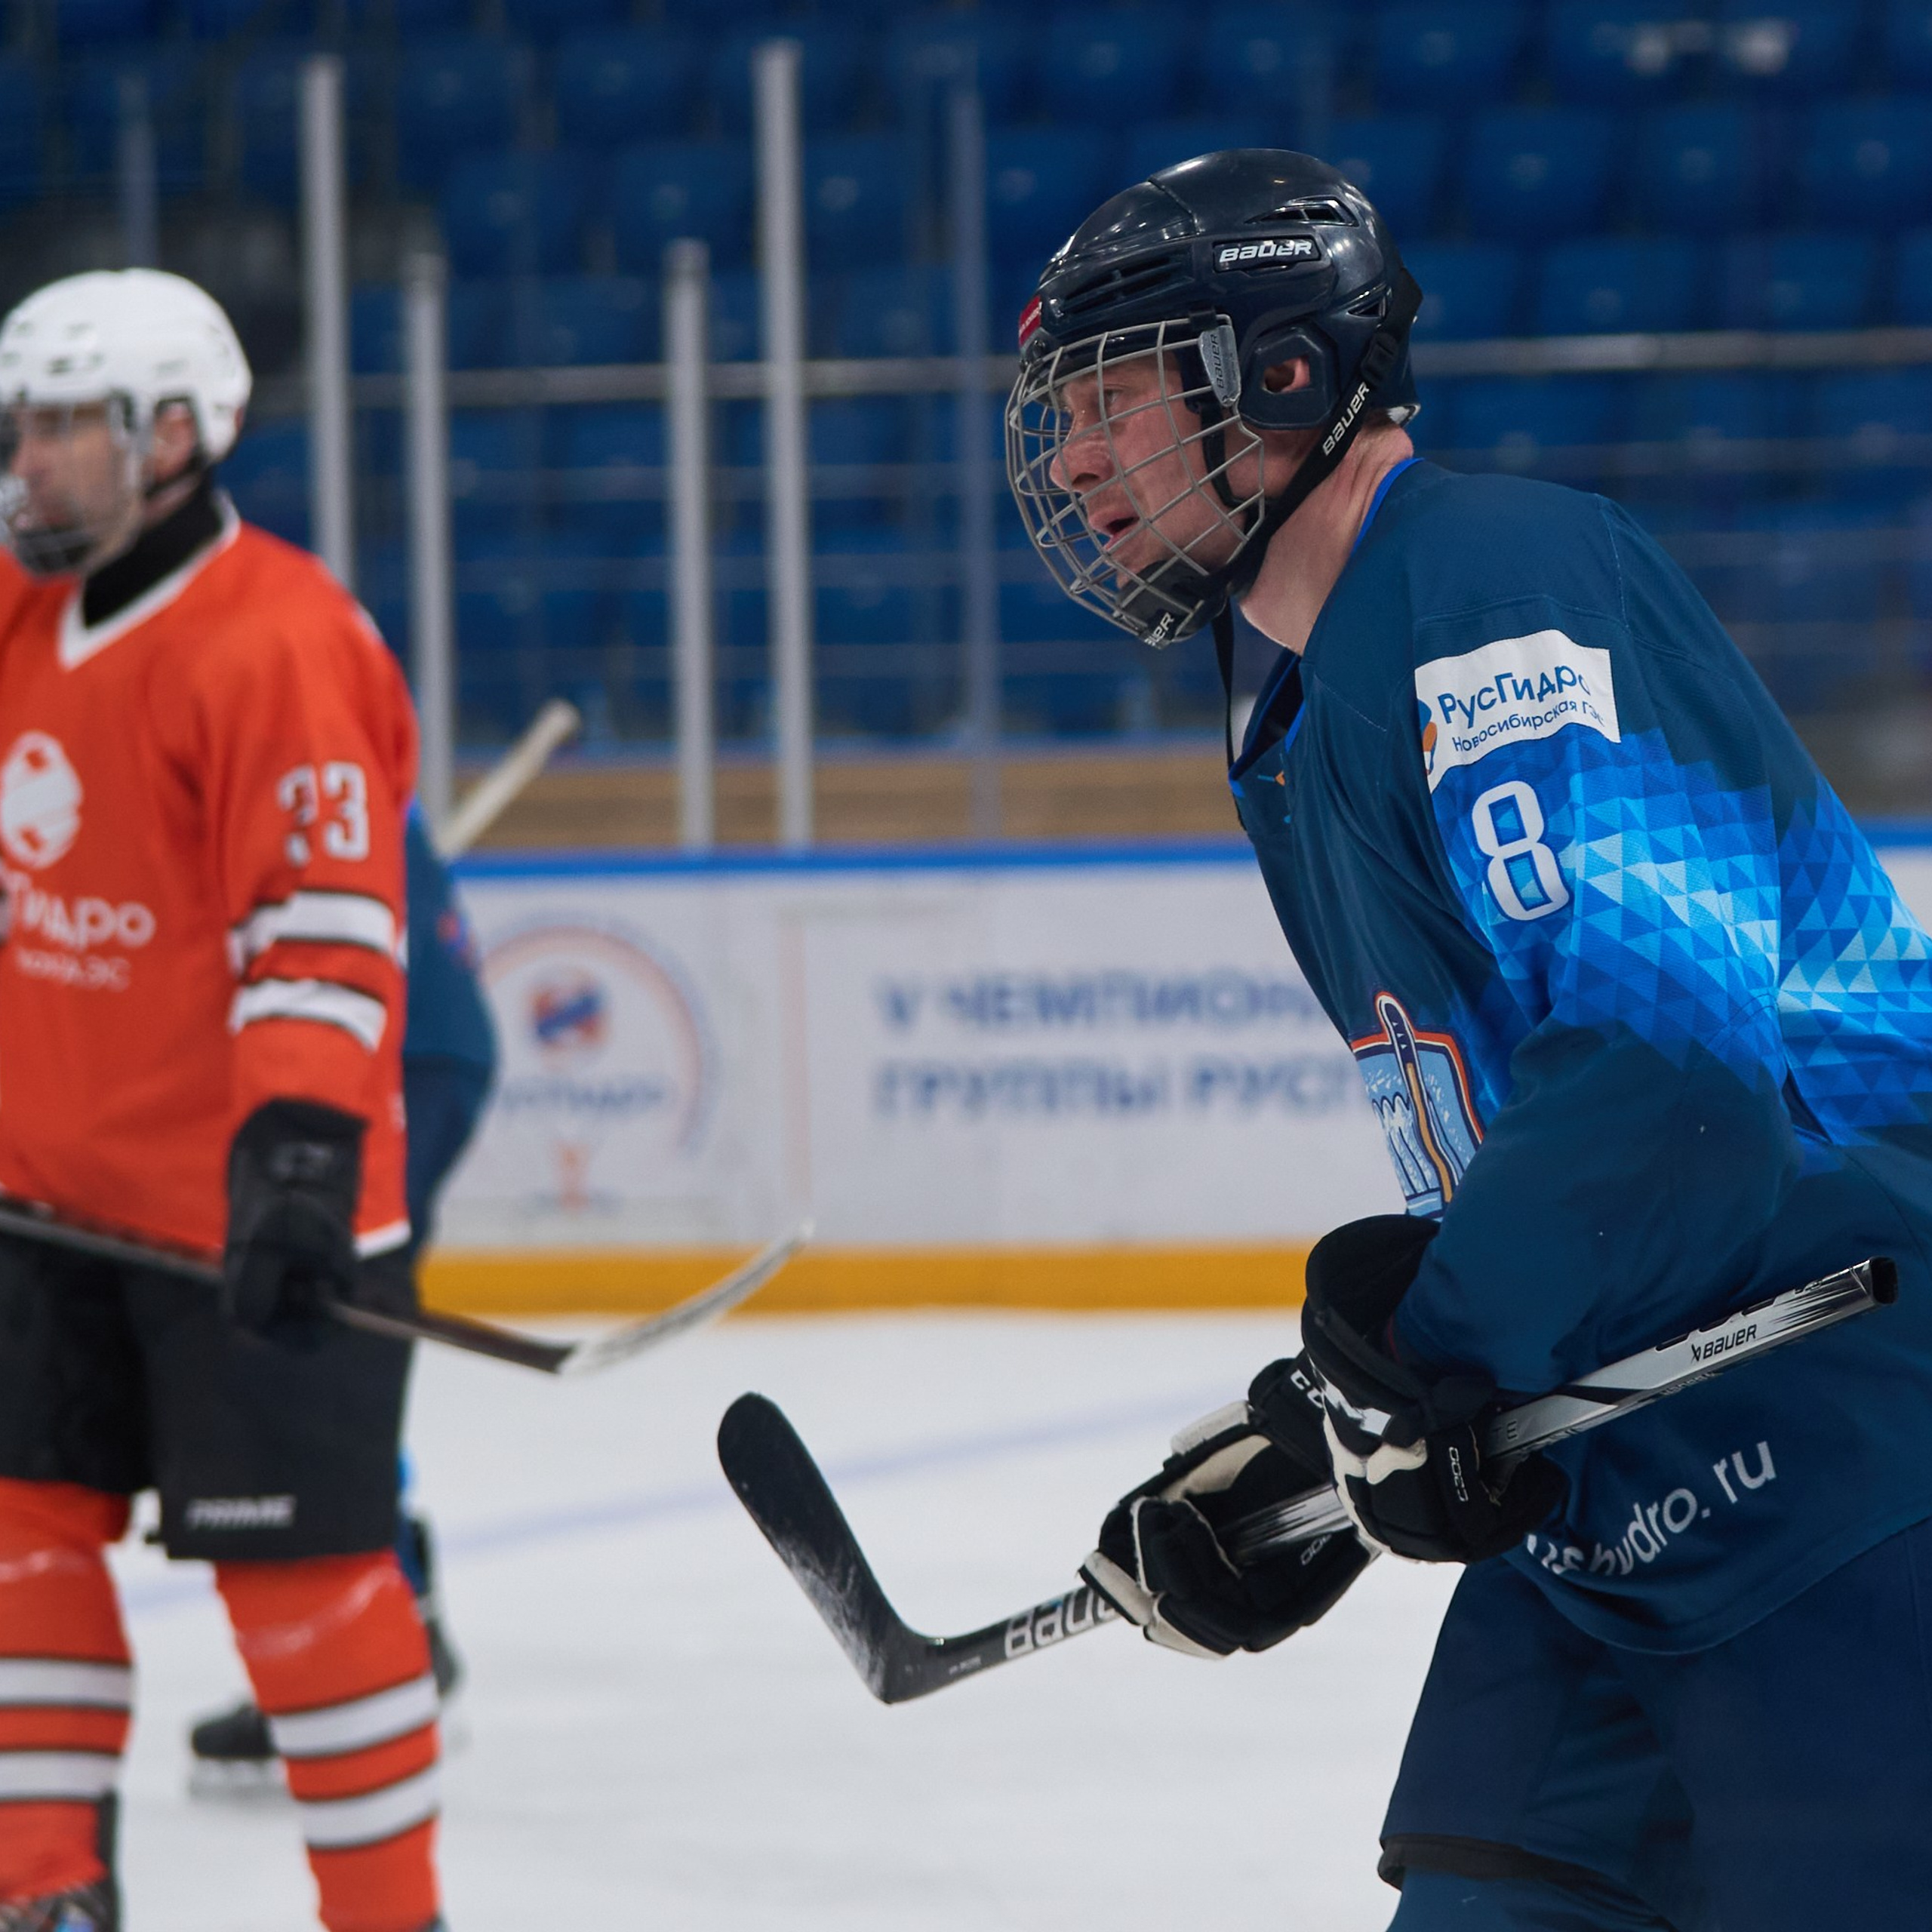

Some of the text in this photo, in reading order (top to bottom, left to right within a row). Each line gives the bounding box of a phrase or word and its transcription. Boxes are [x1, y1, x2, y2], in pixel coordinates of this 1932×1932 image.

[1219, 241, 1312, 263] BAUER
[1210, 334, 1224, 389] BAUER
[1322, 382, 1370, 456] BAUER
[1452, 700, 1577, 752] Новосибирская
[1472, 780, 1570, 921] 8
[942, 972, 1325, 1032] ЧЕМПИОН
[1703, 1324, 1758, 1360] BAUER
[1291, 1369, 1324, 1408] CC
